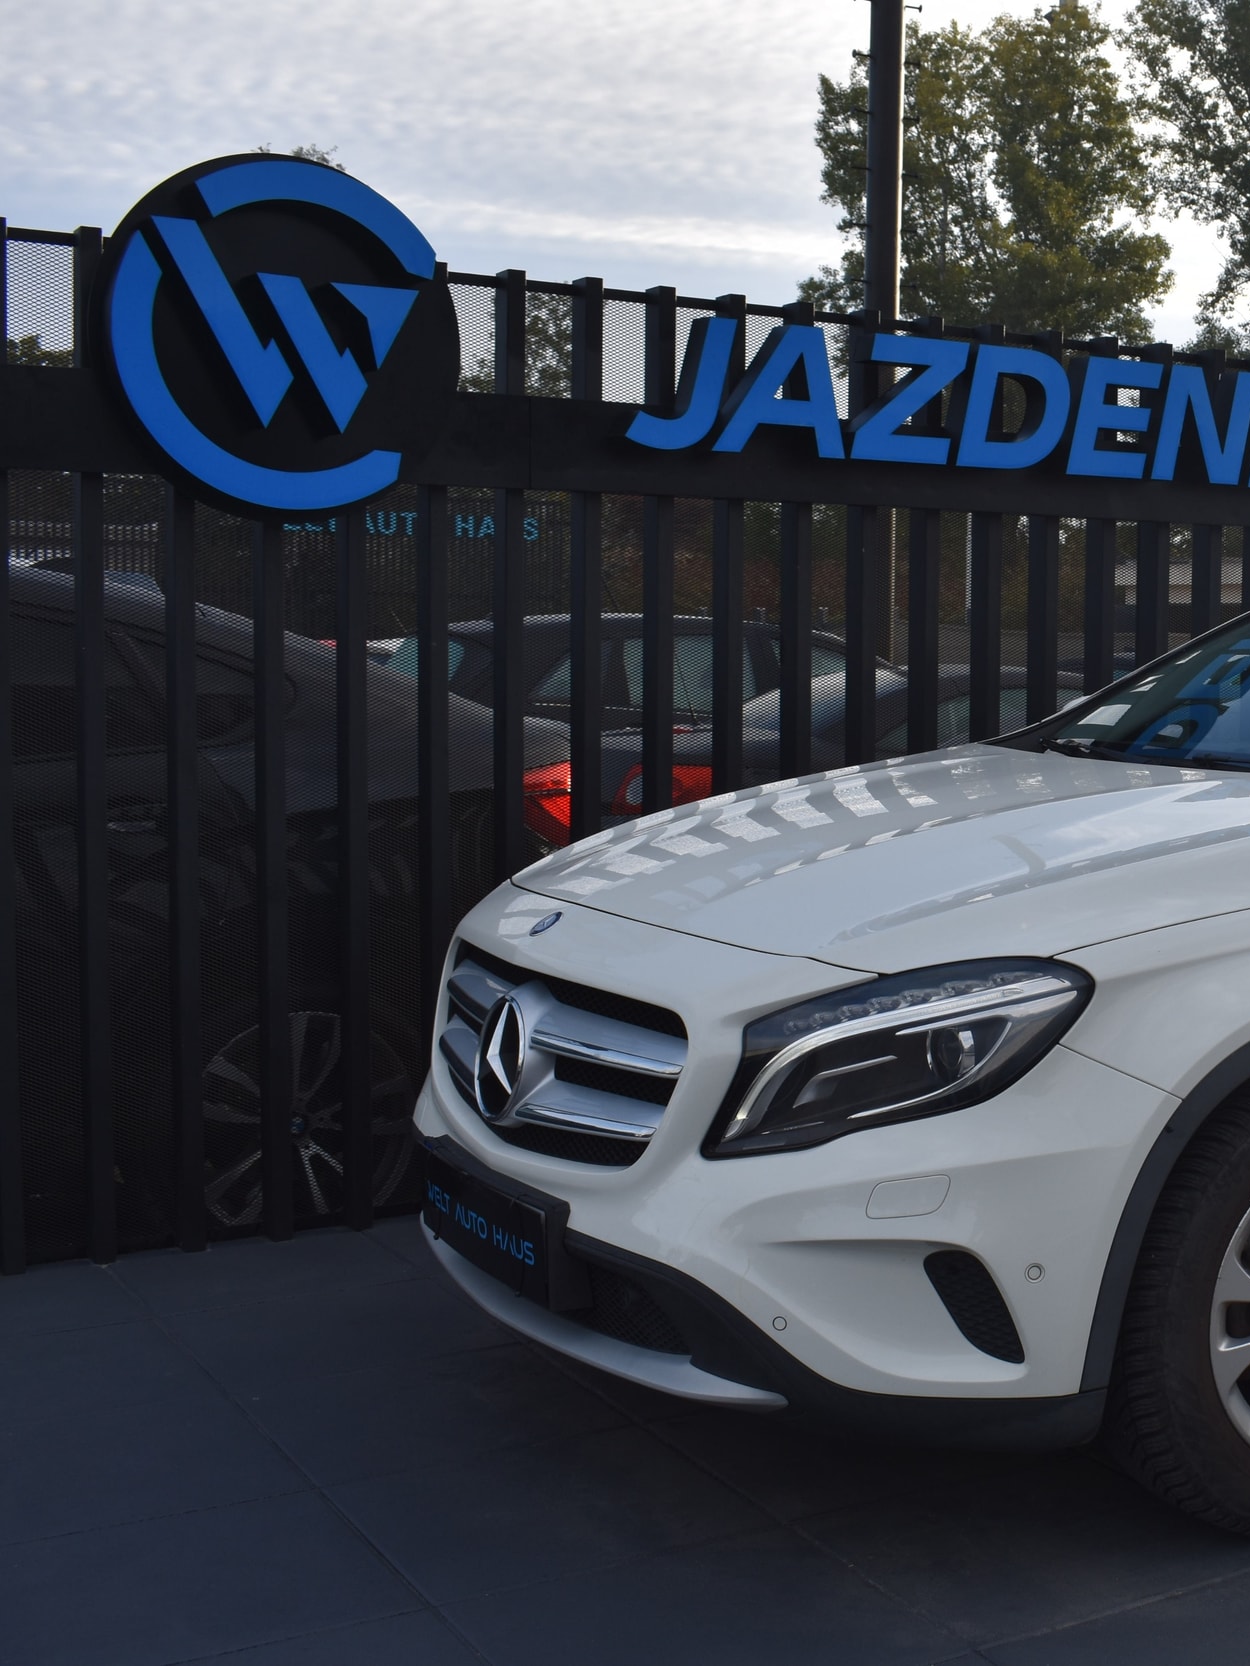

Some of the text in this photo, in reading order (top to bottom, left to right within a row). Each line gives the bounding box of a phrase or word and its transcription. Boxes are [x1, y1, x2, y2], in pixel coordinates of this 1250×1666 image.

[455, 514, 539, 541] HAS
[455, 1201, 488, 1240] AUTO
[492, 1223, 536, 1266] HAUS
